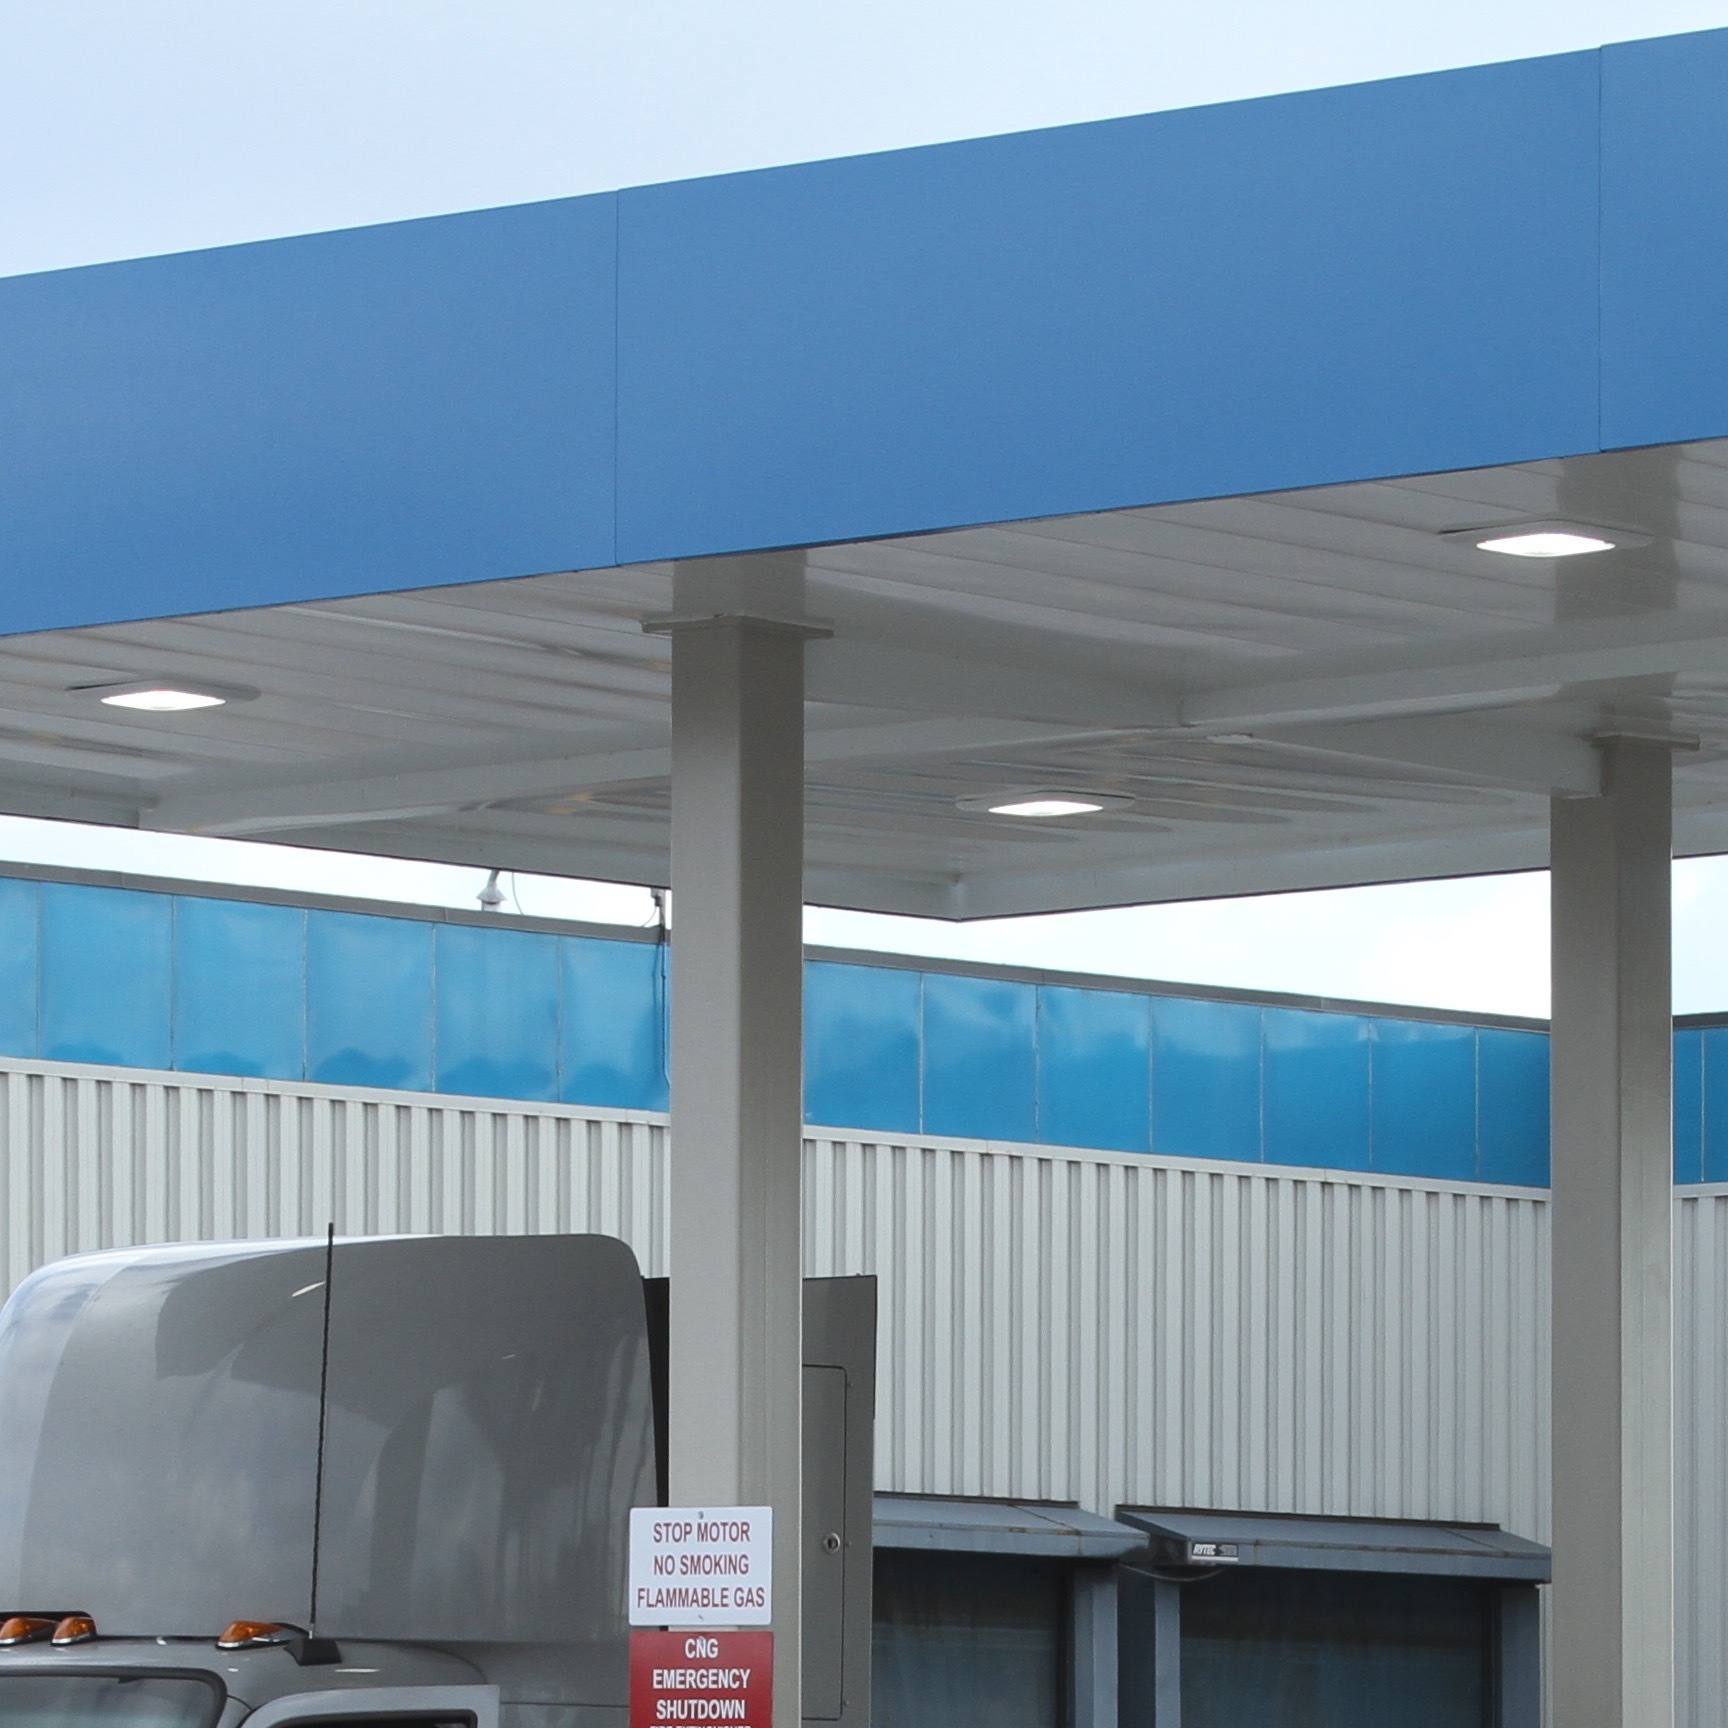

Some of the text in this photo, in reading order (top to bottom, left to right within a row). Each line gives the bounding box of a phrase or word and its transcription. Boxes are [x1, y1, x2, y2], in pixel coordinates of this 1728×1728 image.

[653, 1521, 751, 1543] STOP MOTOR
[654, 1554, 749, 1576] NO SMOKING
[637, 1587, 765, 1608] FLAMMABLE GAS
[685, 1638, 719, 1659] CNG
[652, 1668, 751, 1689] EMERGENCY
[656, 1699, 745, 1719] SHUTDOWN
